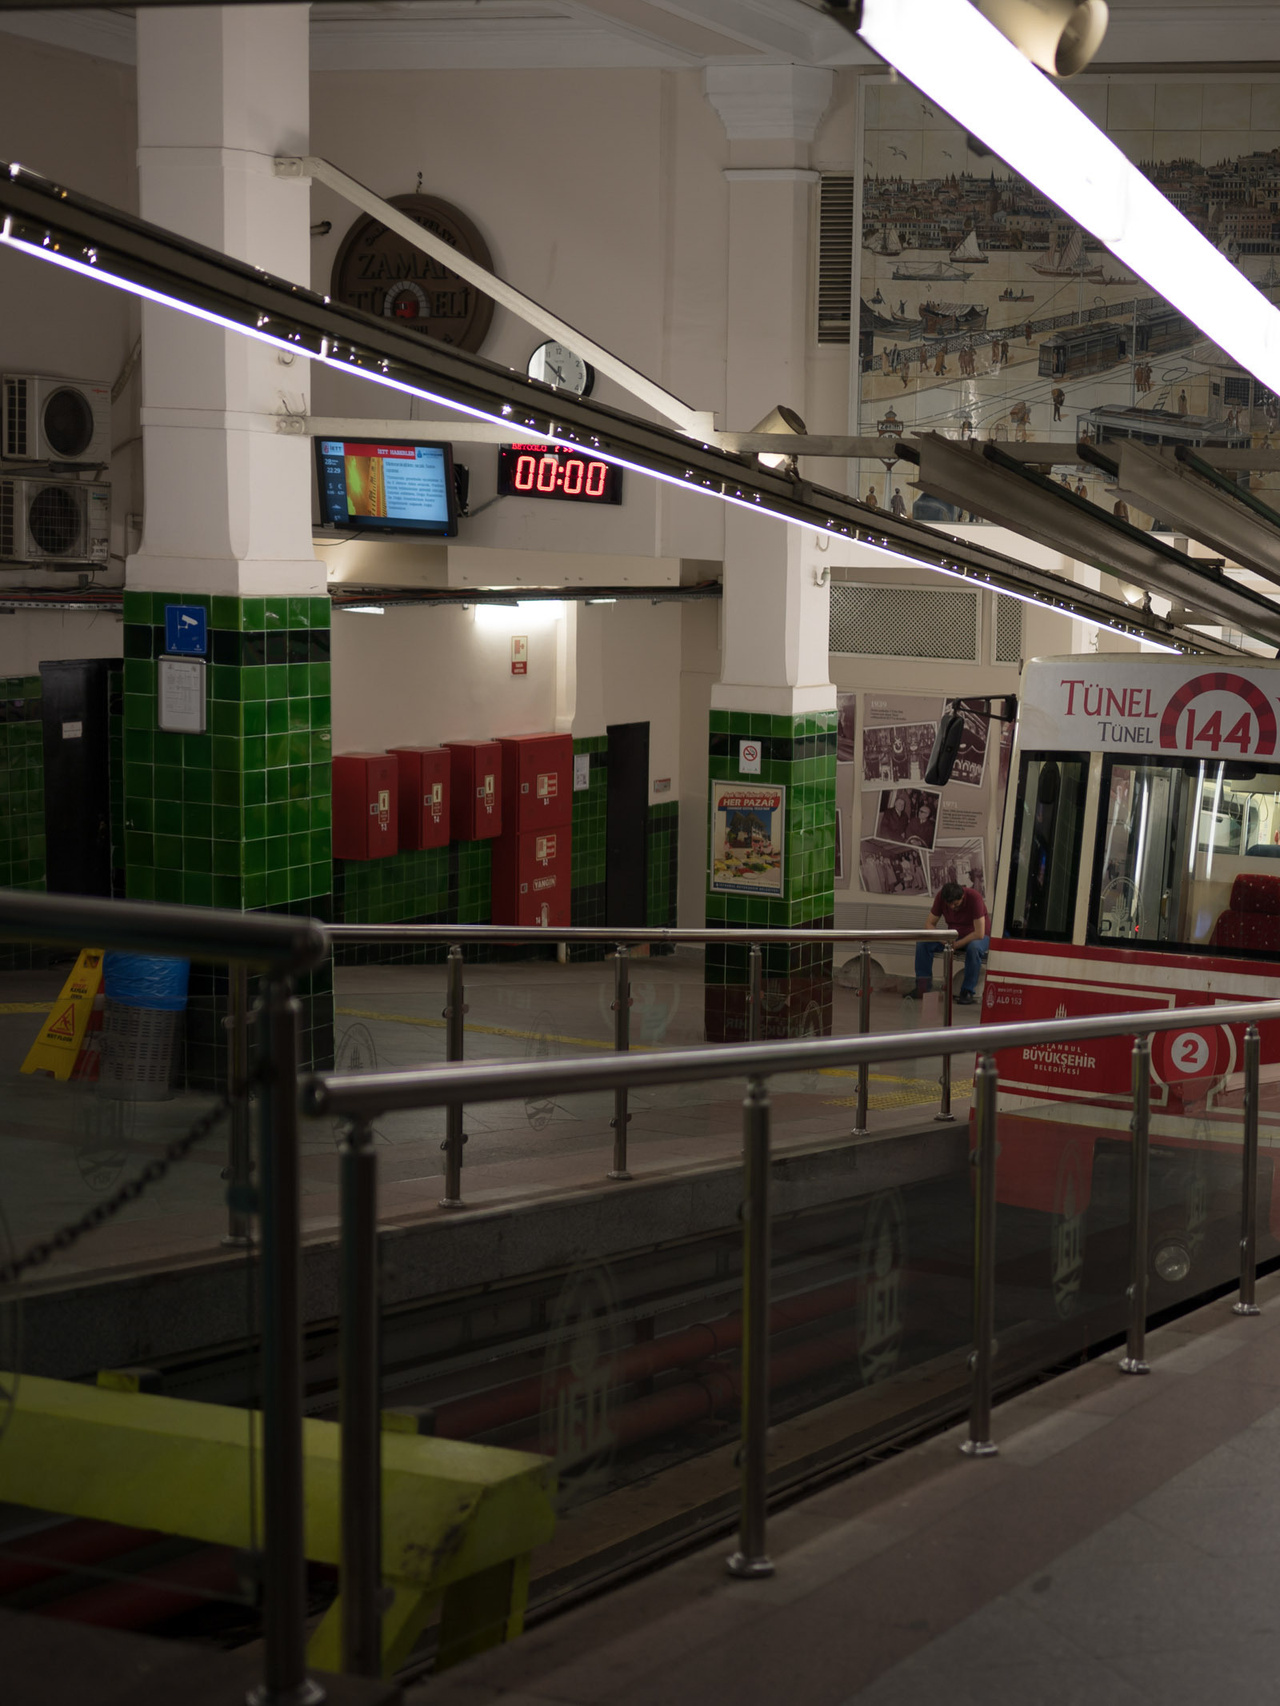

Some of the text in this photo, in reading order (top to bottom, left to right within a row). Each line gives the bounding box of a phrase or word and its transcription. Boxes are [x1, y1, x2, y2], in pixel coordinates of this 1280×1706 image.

[514, 456, 607, 496] 00:00
[1060, 679, 1158, 719] TÜNEL
[1186, 708, 1252, 754] 144
[1097, 721, 1154, 744] TÜNEL
[723, 798, 774, 807] HER PAZAR
[1022, 1046, 1096, 1069] BÜYÜKŞEHİR
[1181, 1039, 1199, 1064] 2
[1034, 1064, 1080, 1076] BELEDİYESİ
